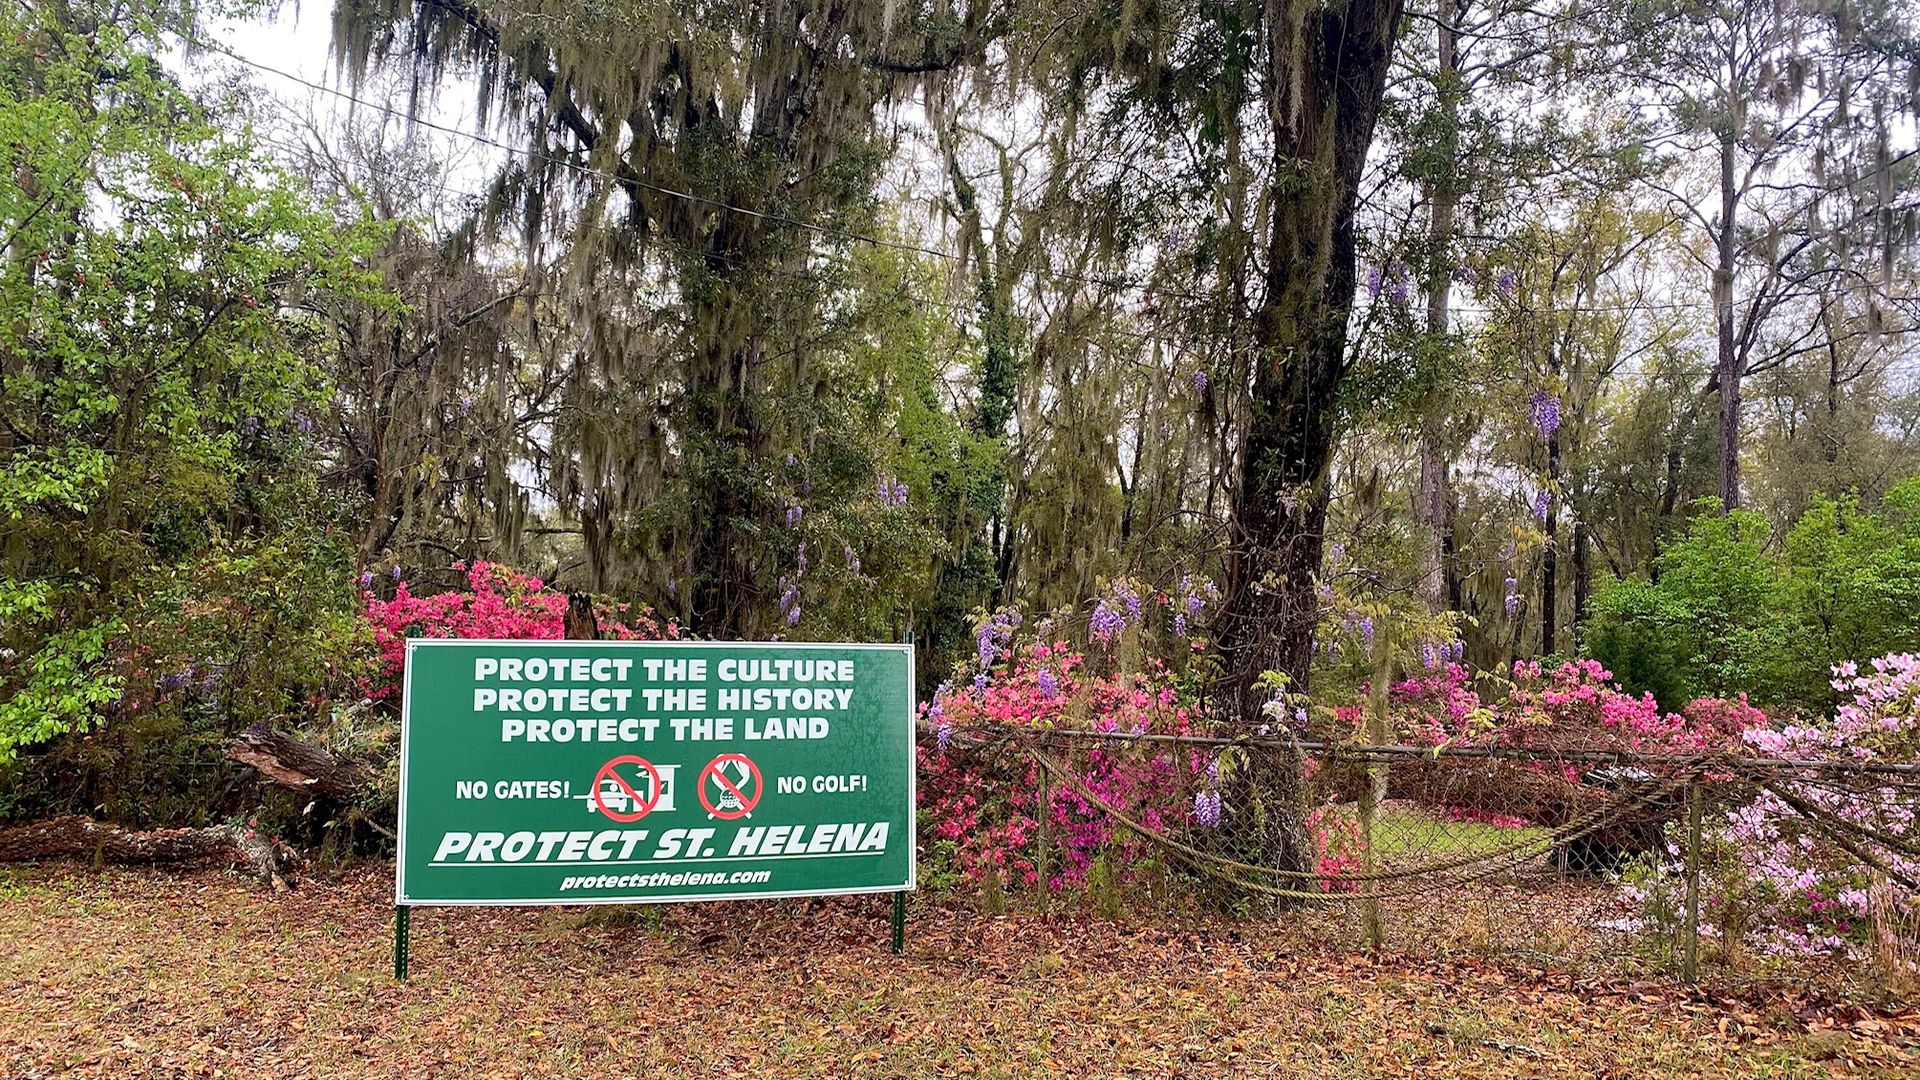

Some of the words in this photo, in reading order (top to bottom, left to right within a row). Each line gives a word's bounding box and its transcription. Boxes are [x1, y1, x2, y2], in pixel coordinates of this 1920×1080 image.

[475, 658, 632, 681] PROTECT
[643, 659, 706, 681] THE
[718, 659, 853, 681] CULTURE
[474, 689, 632, 711] PROTECT
[643, 689, 706, 710] THE
[718, 688, 853, 710] HISTORY
[502, 719, 659, 742] PROTECT
[670, 719, 733, 740] THE
[745, 718, 829, 739] LAND
[457, 781, 487, 799] NO
[495, 781, 569, 799] GATES!
[778, 776, 806, 793] NO
[813, 775, 866, 793] GOLF!
[434, 831, 649, 861] PROTECT
[654, 830, 715, 857] ST.
[728, 822, 889, 855] HELENA
[560, 870, 771, 891] protectsthelena.com
